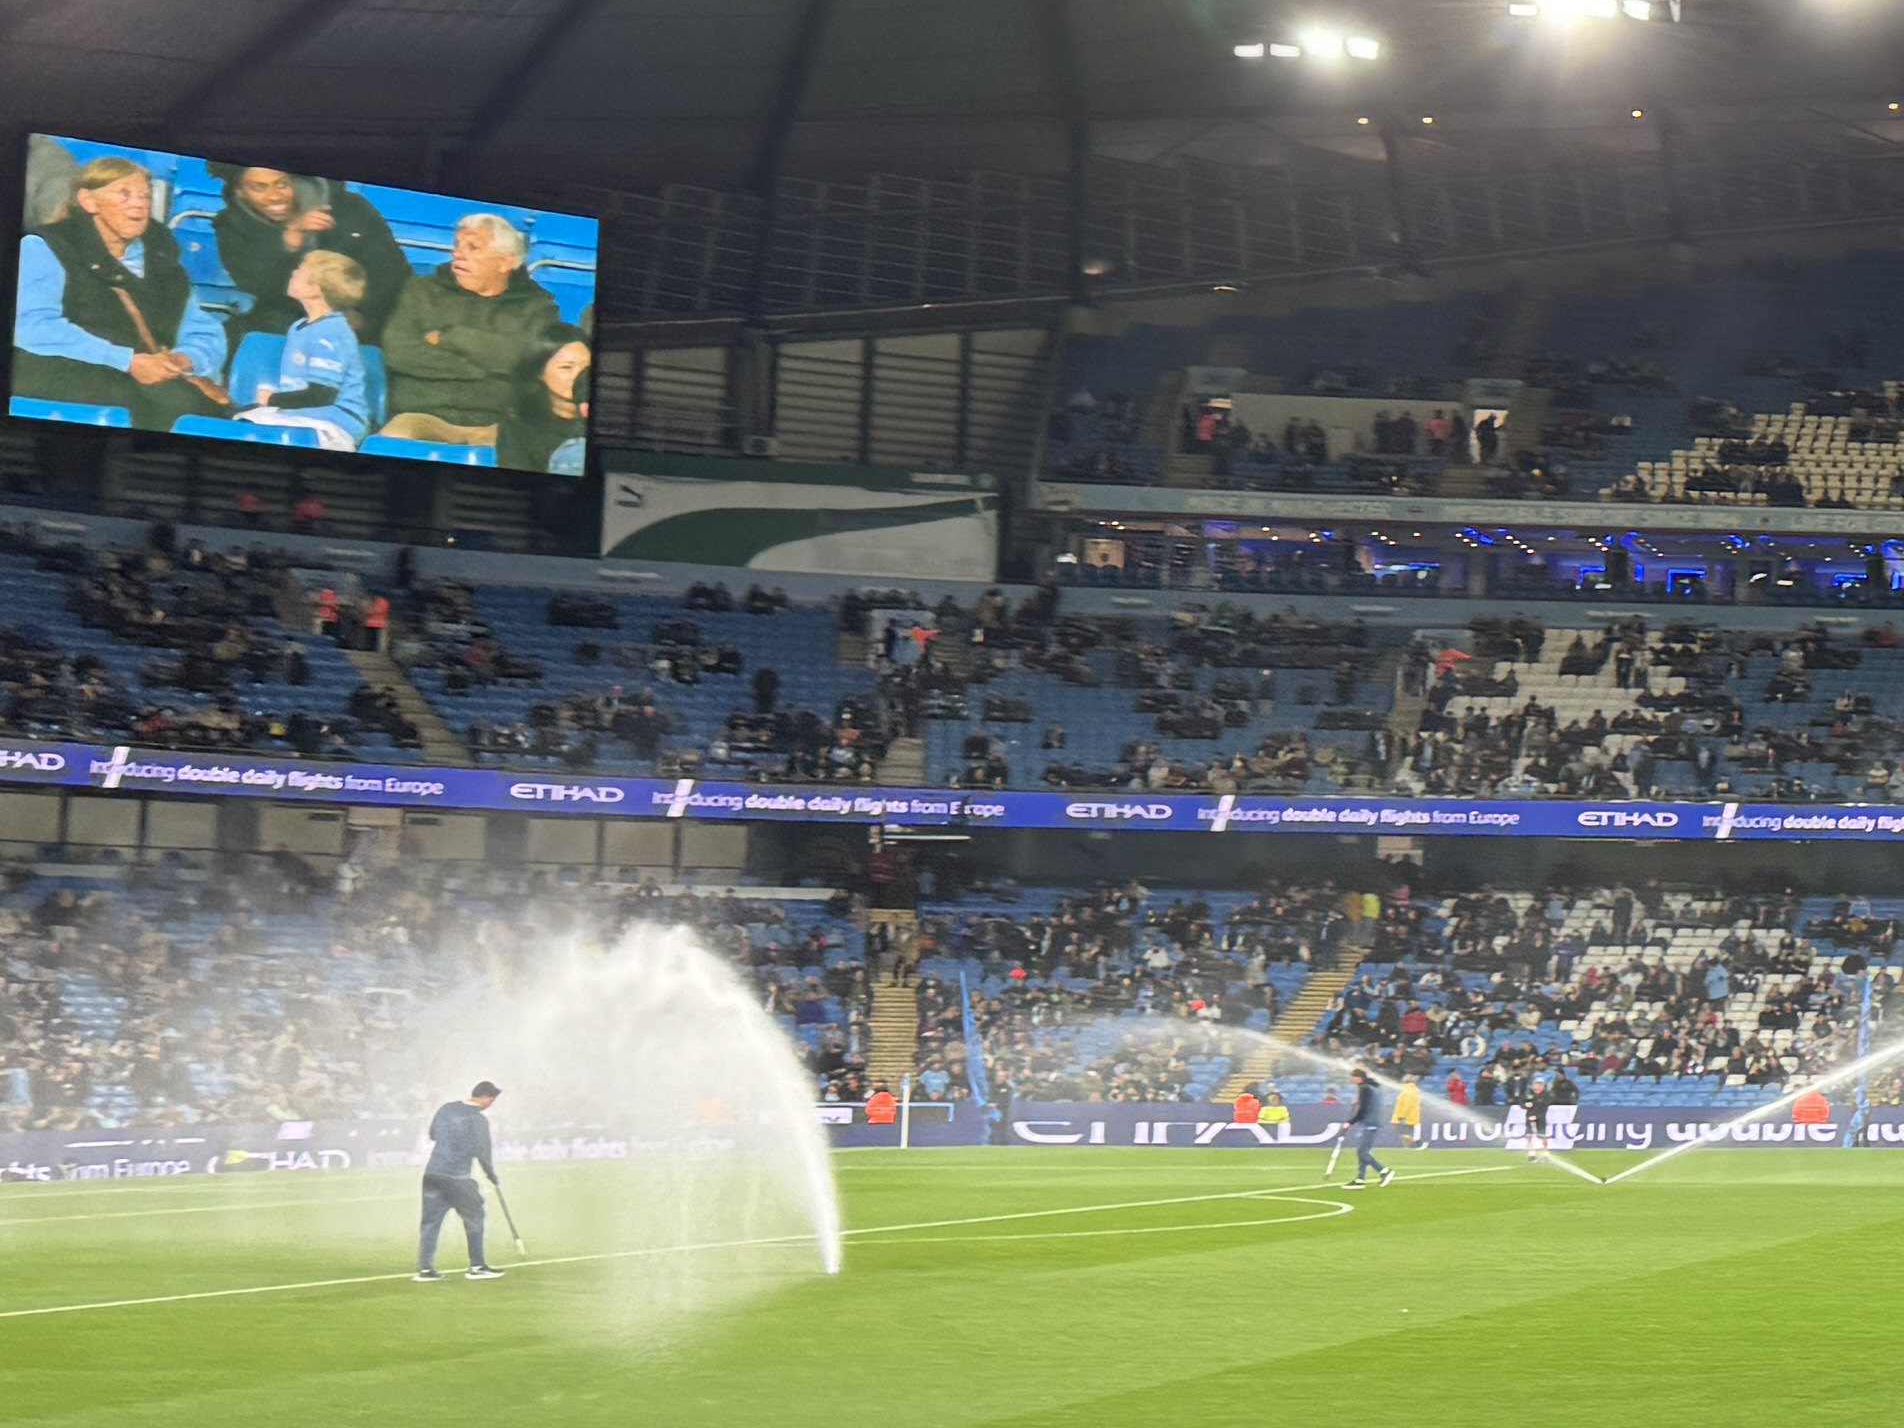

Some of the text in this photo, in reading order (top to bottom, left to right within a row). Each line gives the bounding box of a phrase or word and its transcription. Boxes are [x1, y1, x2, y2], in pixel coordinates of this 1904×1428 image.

[176, 764, 241, 783] double
[241, 769, 287, 790] daily
[287, 770, 344, 791] flights
[344, 774, 383, 791] from
[384, 777, 444, 796] Europe
[510, 783, 625, 803] ETIHAD
[744, 794, 806, 810] double
[807, 796, 852, 815] daily
[854, 797, 909, 816] flights
[910, 799, 948, 814] from
[1065, 802, 1173, 819] ETIHAD
[1281, 807, 1337, 822] double
[1338, 808, 1379, 826] daily
[1379, 809, 1431, 826] flights
[1432, 810, 1467, 824] from
[1468, 810, 1520, 827] Europe
[1577, 811, 1679, 827] ETIHAD
[1782, 815, 1837, 830] double
[1837, 815, 1877, 832] daily
